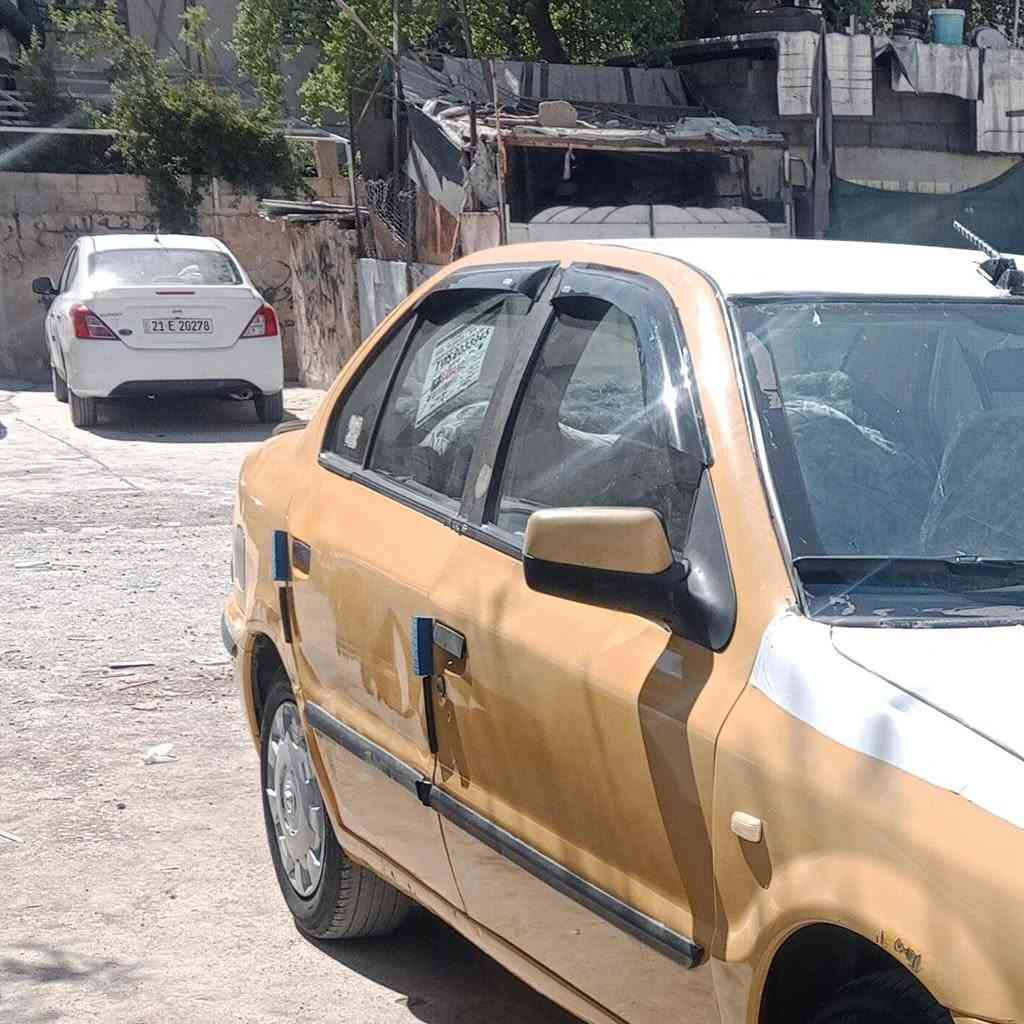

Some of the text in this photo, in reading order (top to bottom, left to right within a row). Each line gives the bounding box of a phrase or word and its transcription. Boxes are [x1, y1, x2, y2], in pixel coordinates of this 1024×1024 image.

[151, 320, 210, 332] 21 E 20278
